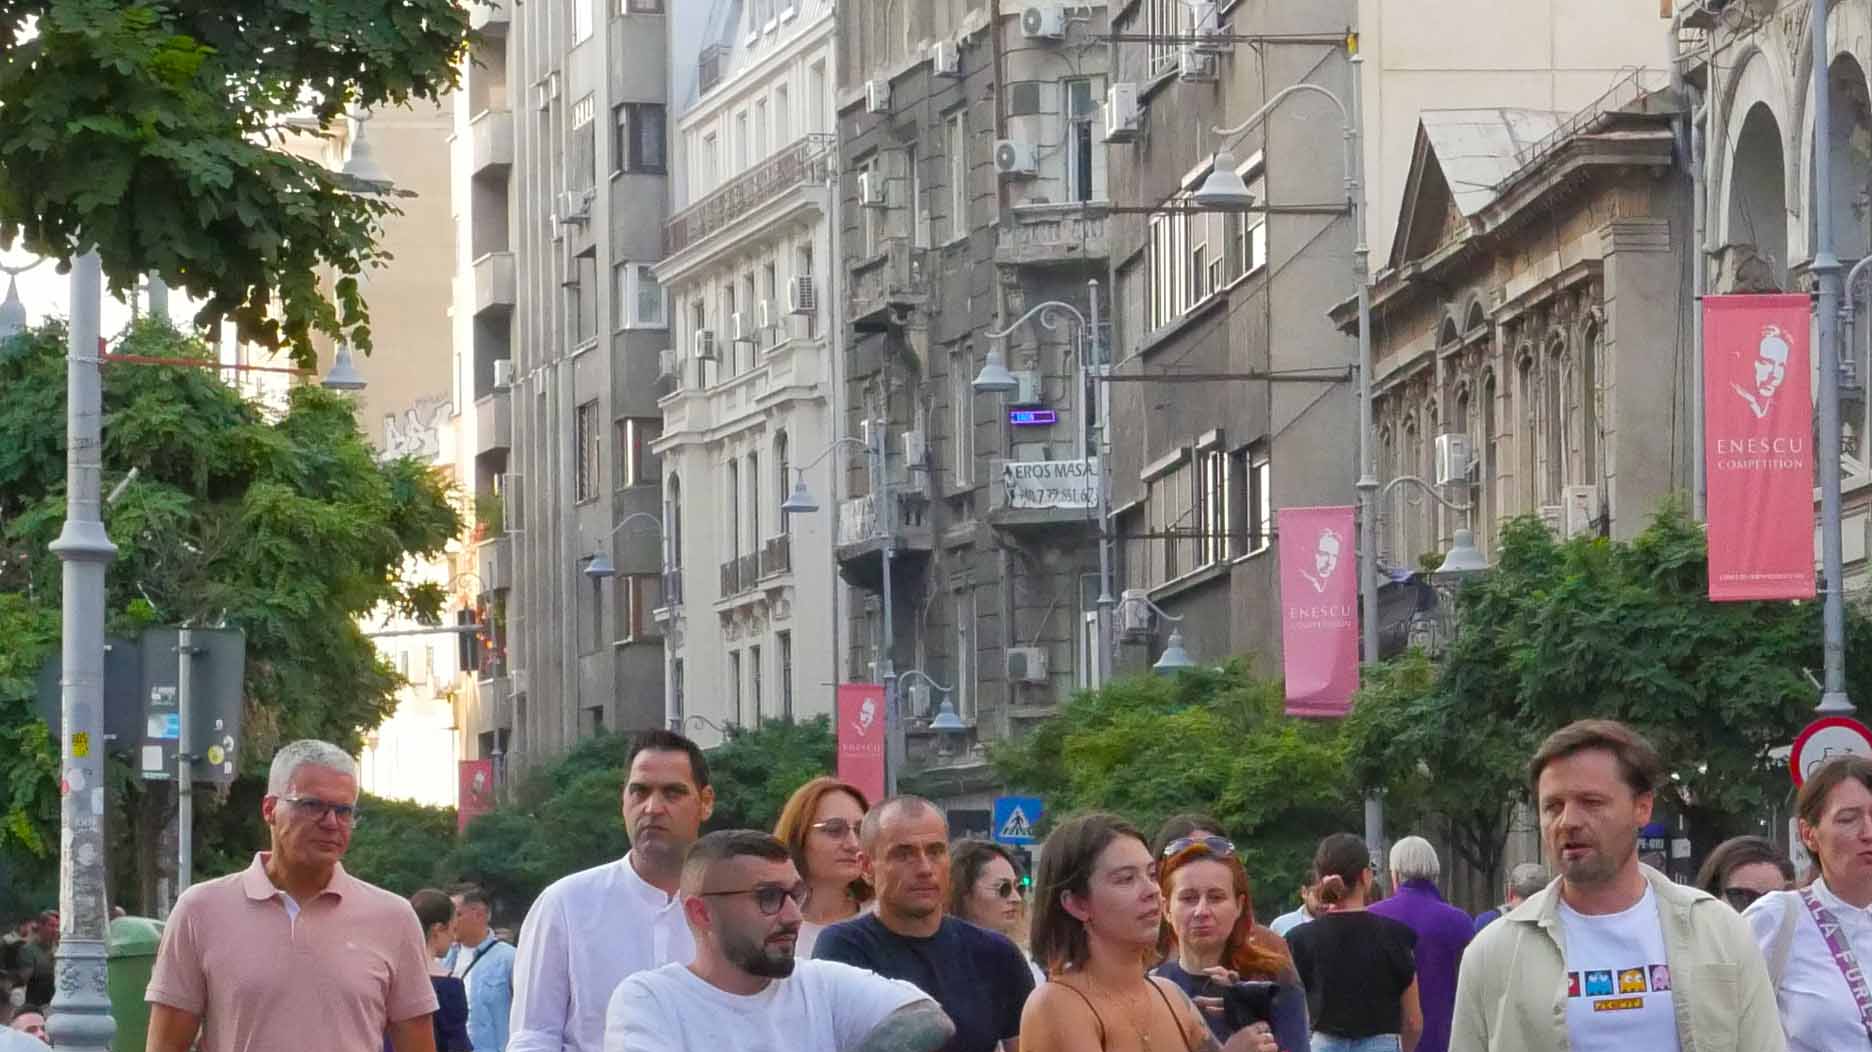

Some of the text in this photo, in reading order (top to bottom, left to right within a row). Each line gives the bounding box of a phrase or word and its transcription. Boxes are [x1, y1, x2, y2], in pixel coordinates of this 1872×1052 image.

[1717, 438, 1803, 454] ENESCU
[1717, 457, 1803, 471] COMPETITION
[1015, 464, 1051, 480] EROS
[1289, 606, 1352, 619] ENESCU
